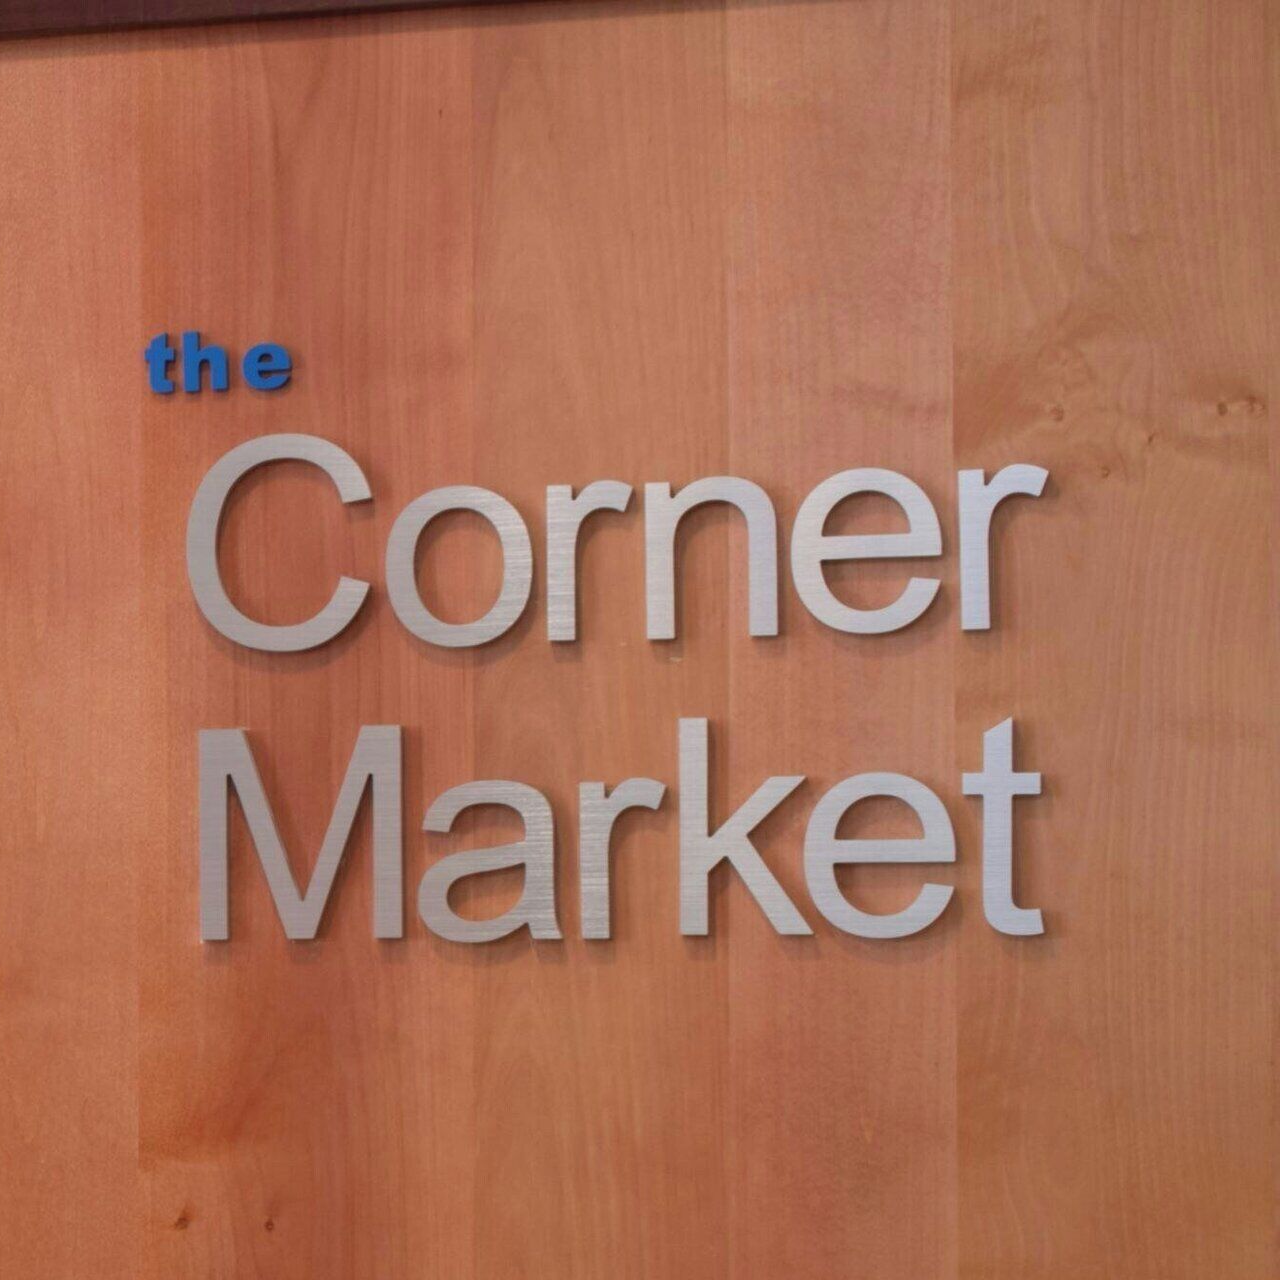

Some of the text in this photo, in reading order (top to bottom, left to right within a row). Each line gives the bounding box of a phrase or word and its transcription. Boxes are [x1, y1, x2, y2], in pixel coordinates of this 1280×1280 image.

[144, 331, 293, 394] the
[185, 432, 1049, 653] Corner
[197, 716, 1045, 944] Market
